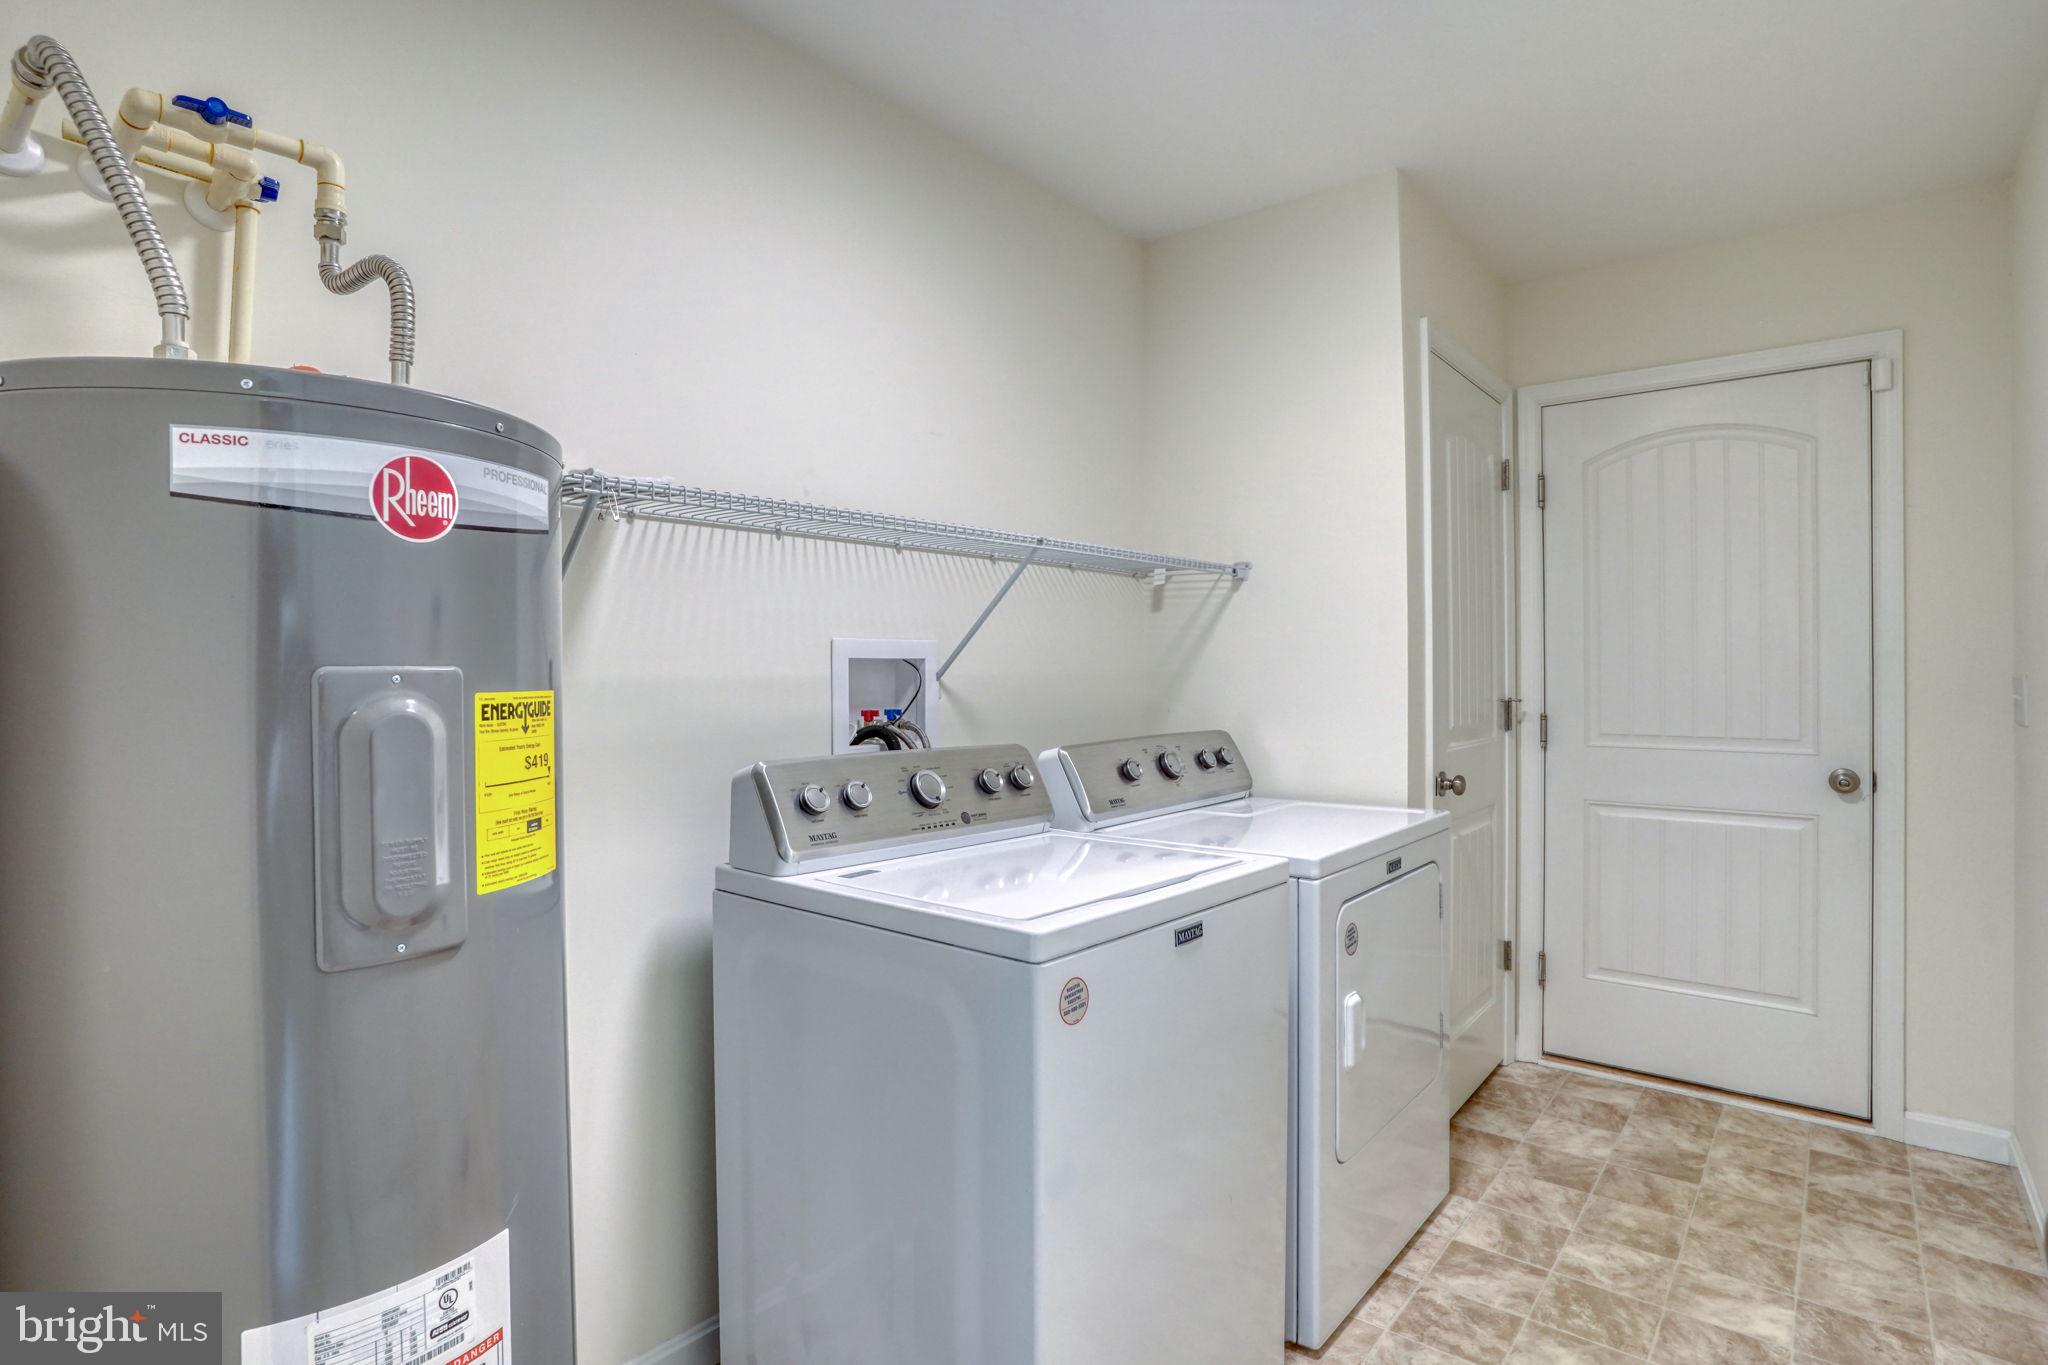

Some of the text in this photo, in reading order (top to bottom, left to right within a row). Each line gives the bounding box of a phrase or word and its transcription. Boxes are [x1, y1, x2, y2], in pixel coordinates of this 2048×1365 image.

[179, 432, 249, 446] CLASSIC
[483, 467, 548, 495] PROFESSIONAL
[383, 457, 453, 527] Rheem
[808, 832, 838, 843] MAYTAG
[1178, 924, 1203, 944] MAYTAG
